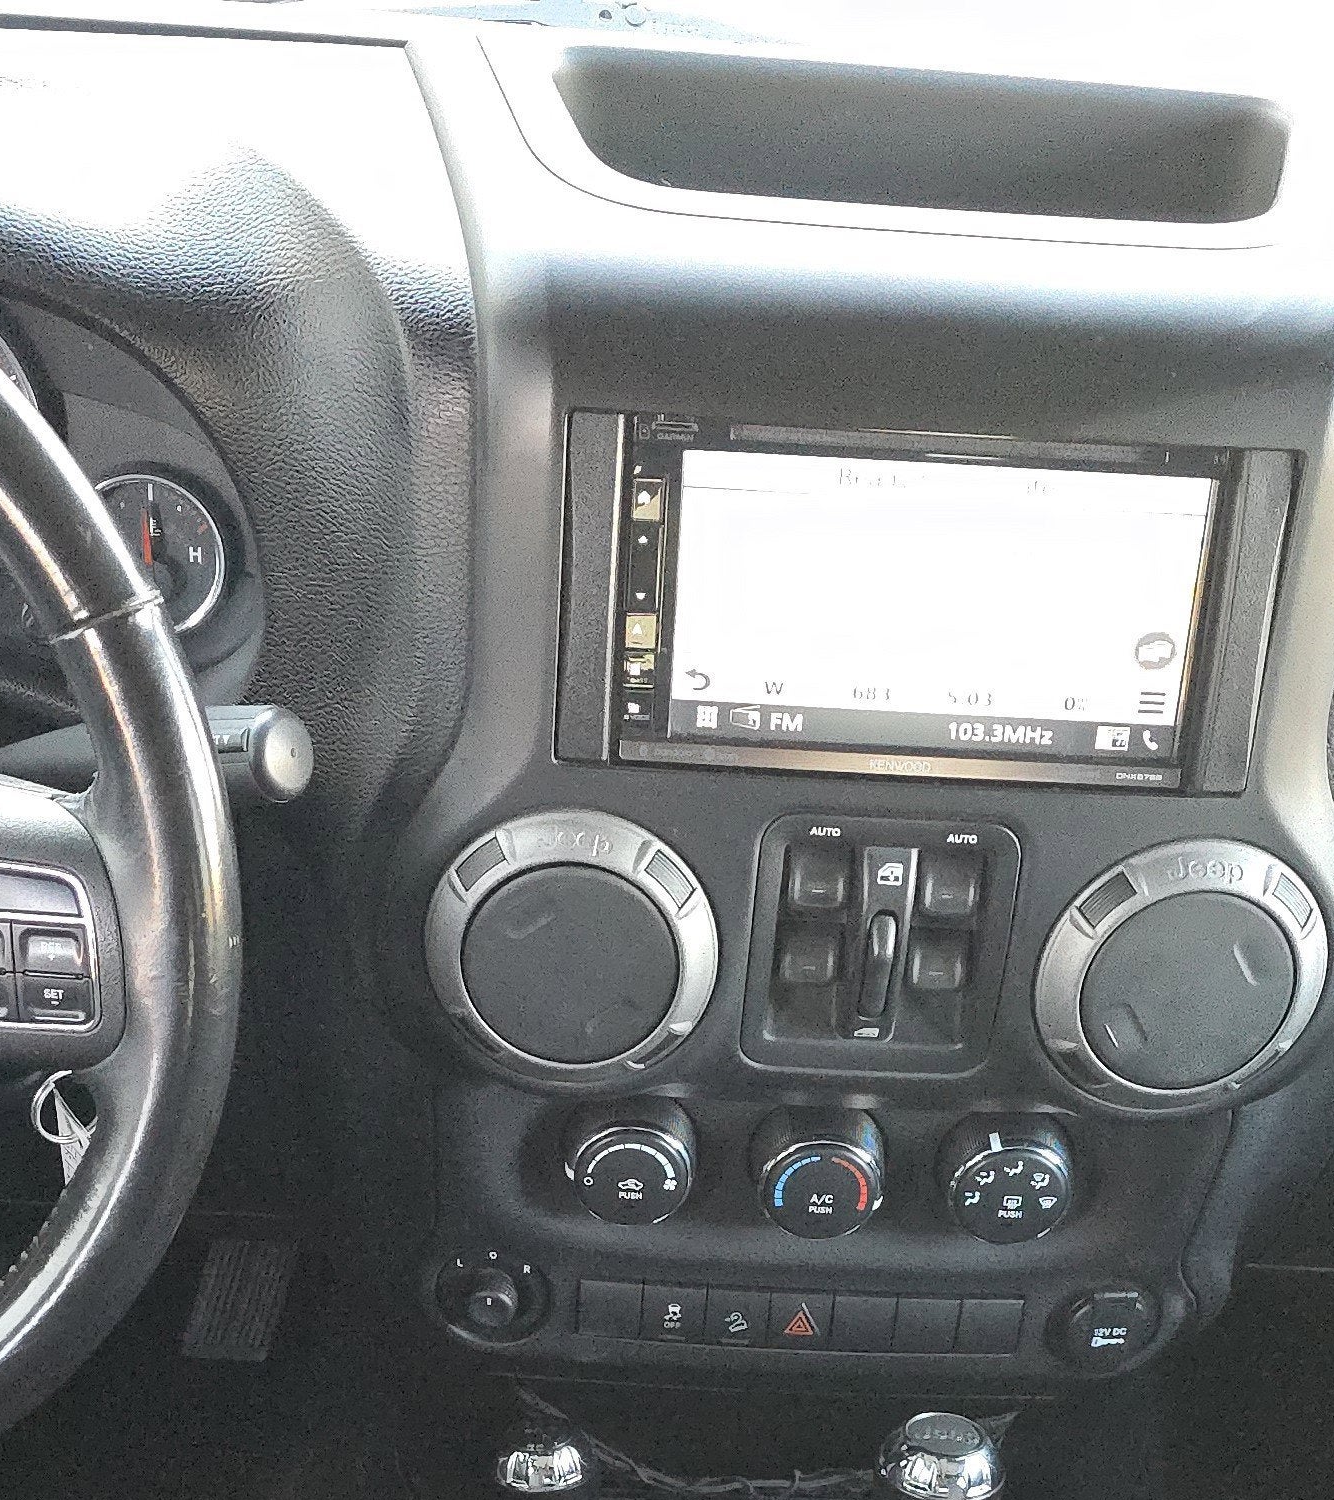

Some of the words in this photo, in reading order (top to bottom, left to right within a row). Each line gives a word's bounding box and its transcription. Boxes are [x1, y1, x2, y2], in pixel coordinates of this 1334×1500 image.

[188, 546, 203, 565] H
[769, 711, 804, 733] FM
[948, 720, 1054, 746] 103.3MHz
[869, 759, 932, 774] KENWOOD
[809, 826, 841, 838] AUTO
[946, 833, 978, 845] AUTO
[43, 988, 64, 1001] SET
[618, 1190, 643, 1201] PUSH
[809, 1193, 835, 1205] A/C
[808, 1205, 834, 1216] PUSH
[997, 1209, 1023, 1220] PUSH
[523, 1264, 532, 1275] R
